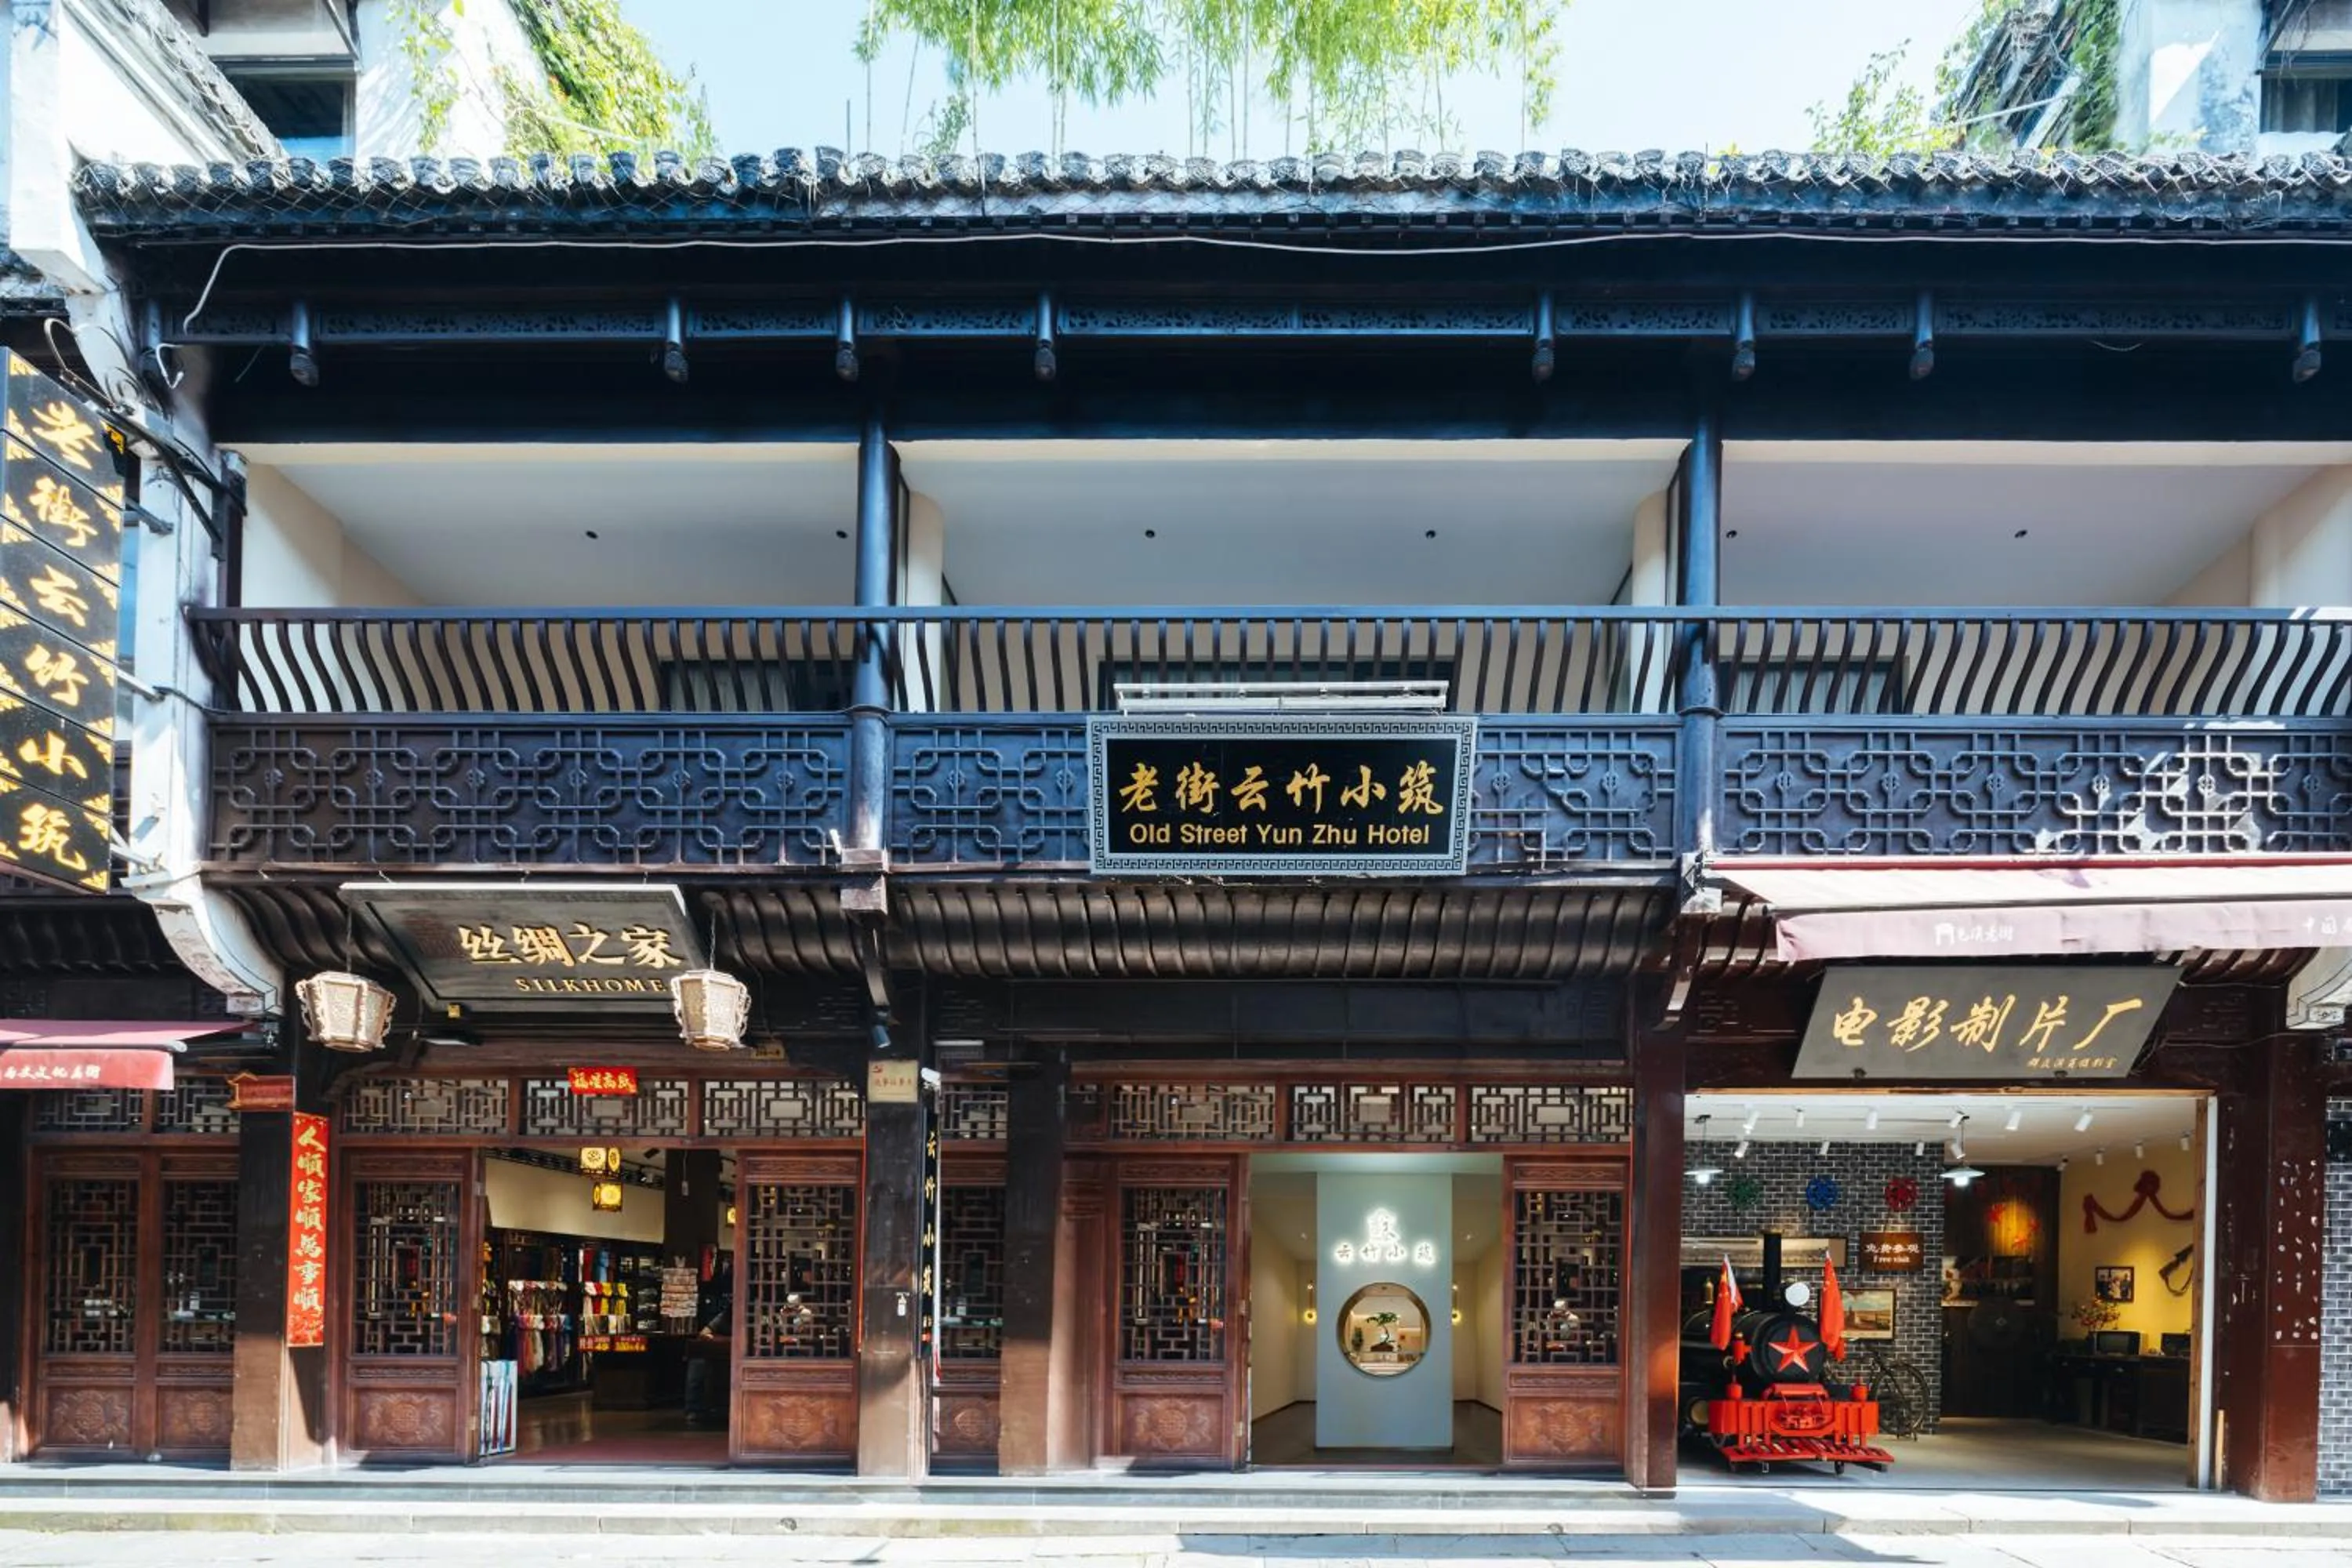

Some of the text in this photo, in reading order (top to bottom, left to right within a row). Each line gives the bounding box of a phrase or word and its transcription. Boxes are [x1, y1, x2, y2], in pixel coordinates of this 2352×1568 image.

[20, 401, 101, 871] 老街云竹小筑
[1120, 760, 1443, 815] 老街云竹小筑
[1130, 823, 1429, 844] Old Street Yun Zhu Hotel
[459, 922, 684, 969] 丝绸之家
[515, 978, 666, 993] SILKHOME
[1832, 994, 2143, 1053] 电影制片厂
